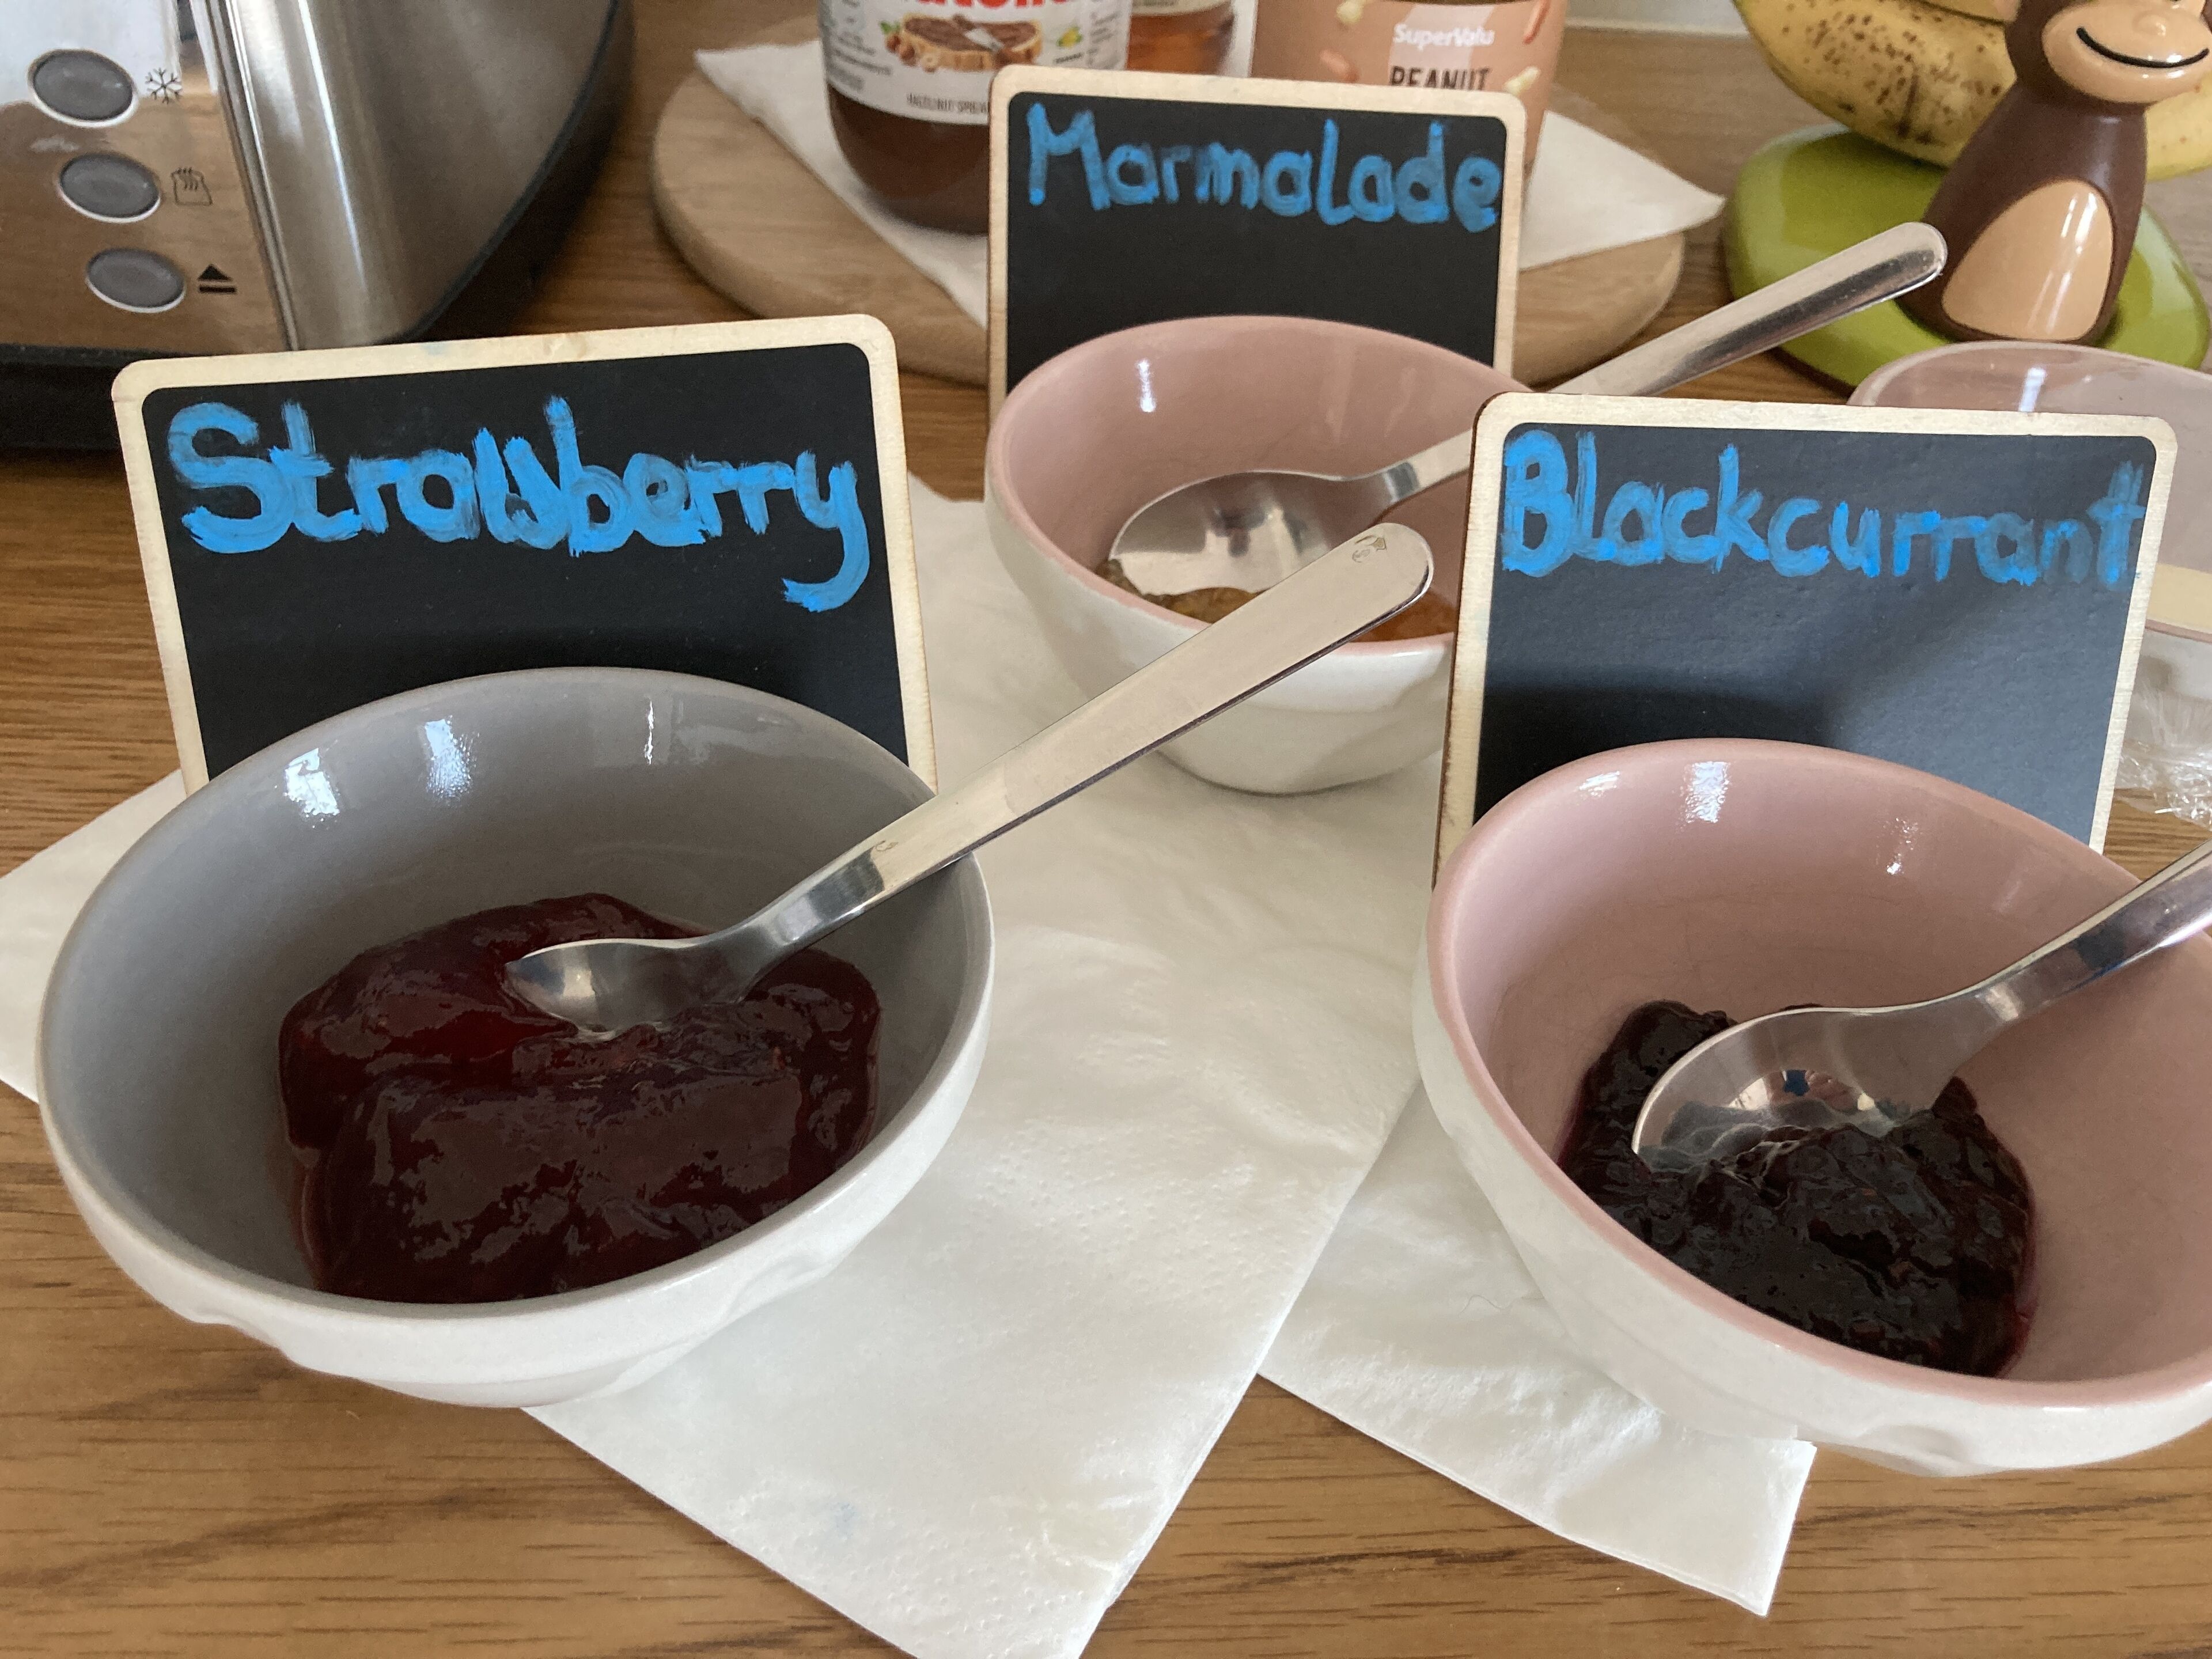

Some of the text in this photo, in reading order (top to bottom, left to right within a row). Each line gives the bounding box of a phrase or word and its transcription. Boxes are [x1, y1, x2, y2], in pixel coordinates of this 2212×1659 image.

[1393, 24, 1495, 53] SuperValu
[1027, 102, 1501, 232] Marmalade
[168, 396, 869, 612] Strawberry
[1502, 430, 2146, 586] Blackcurrant
